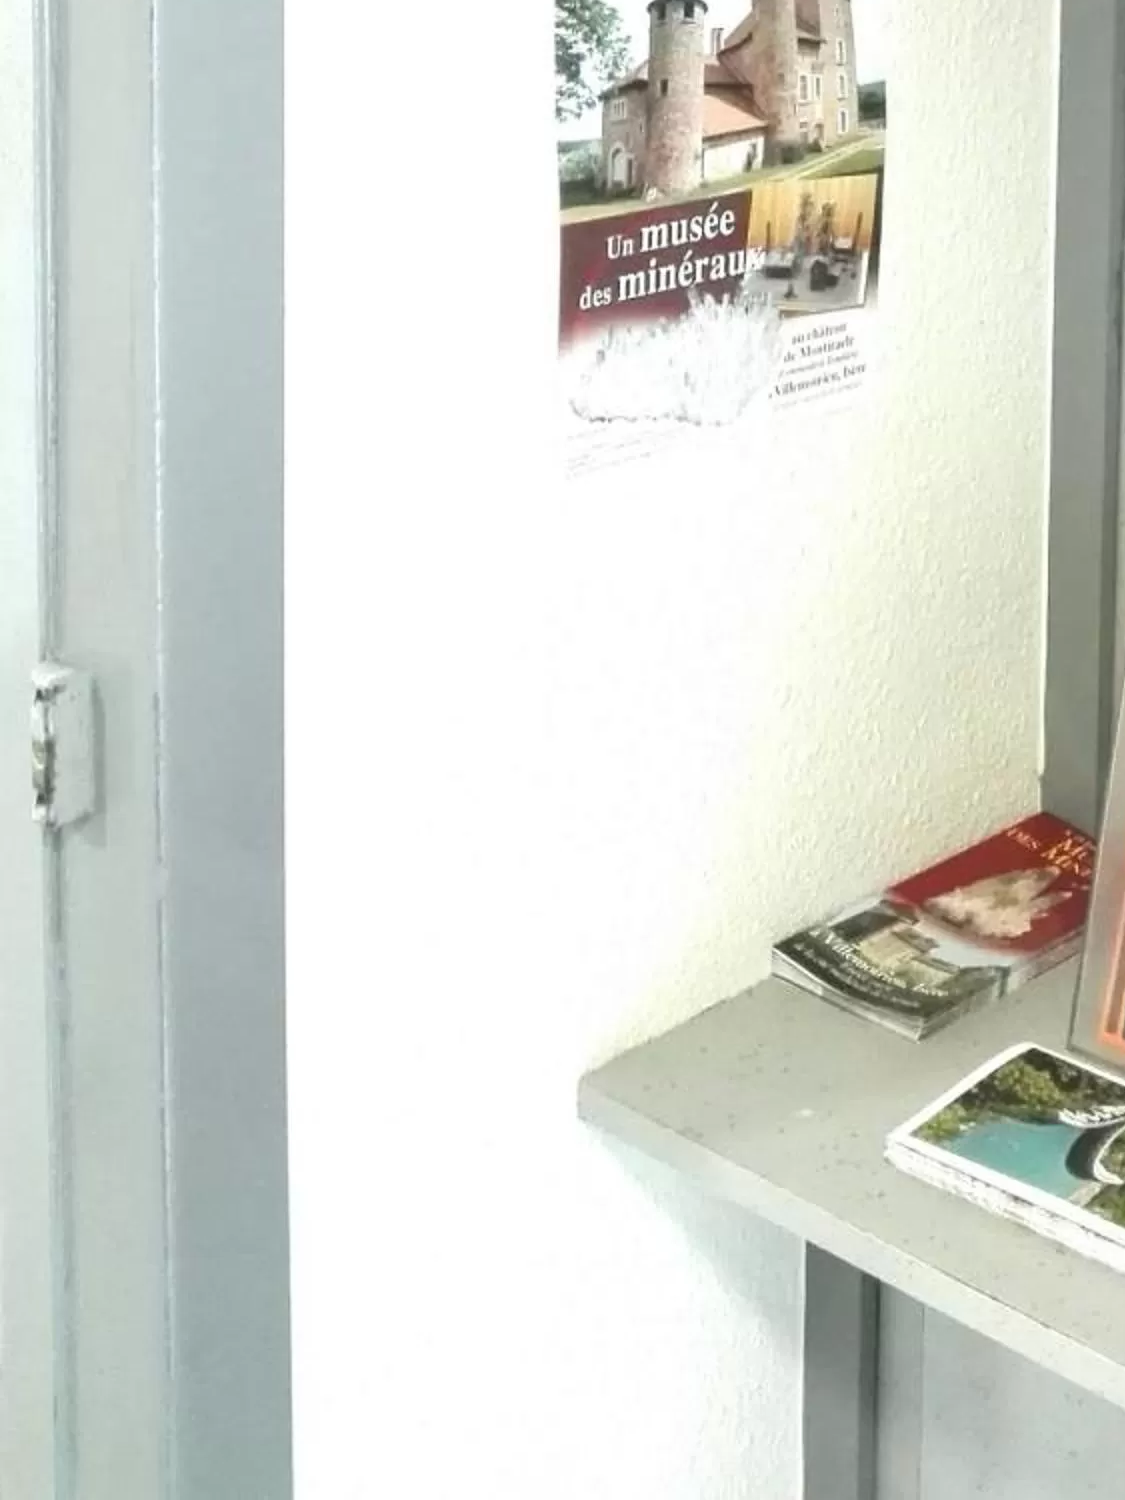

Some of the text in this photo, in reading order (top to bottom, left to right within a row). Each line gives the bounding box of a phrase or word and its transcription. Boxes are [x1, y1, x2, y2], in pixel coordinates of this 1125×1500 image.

[606, 201, 736, 261] Un musée
[579, 246, 767, 311] des minéraux
